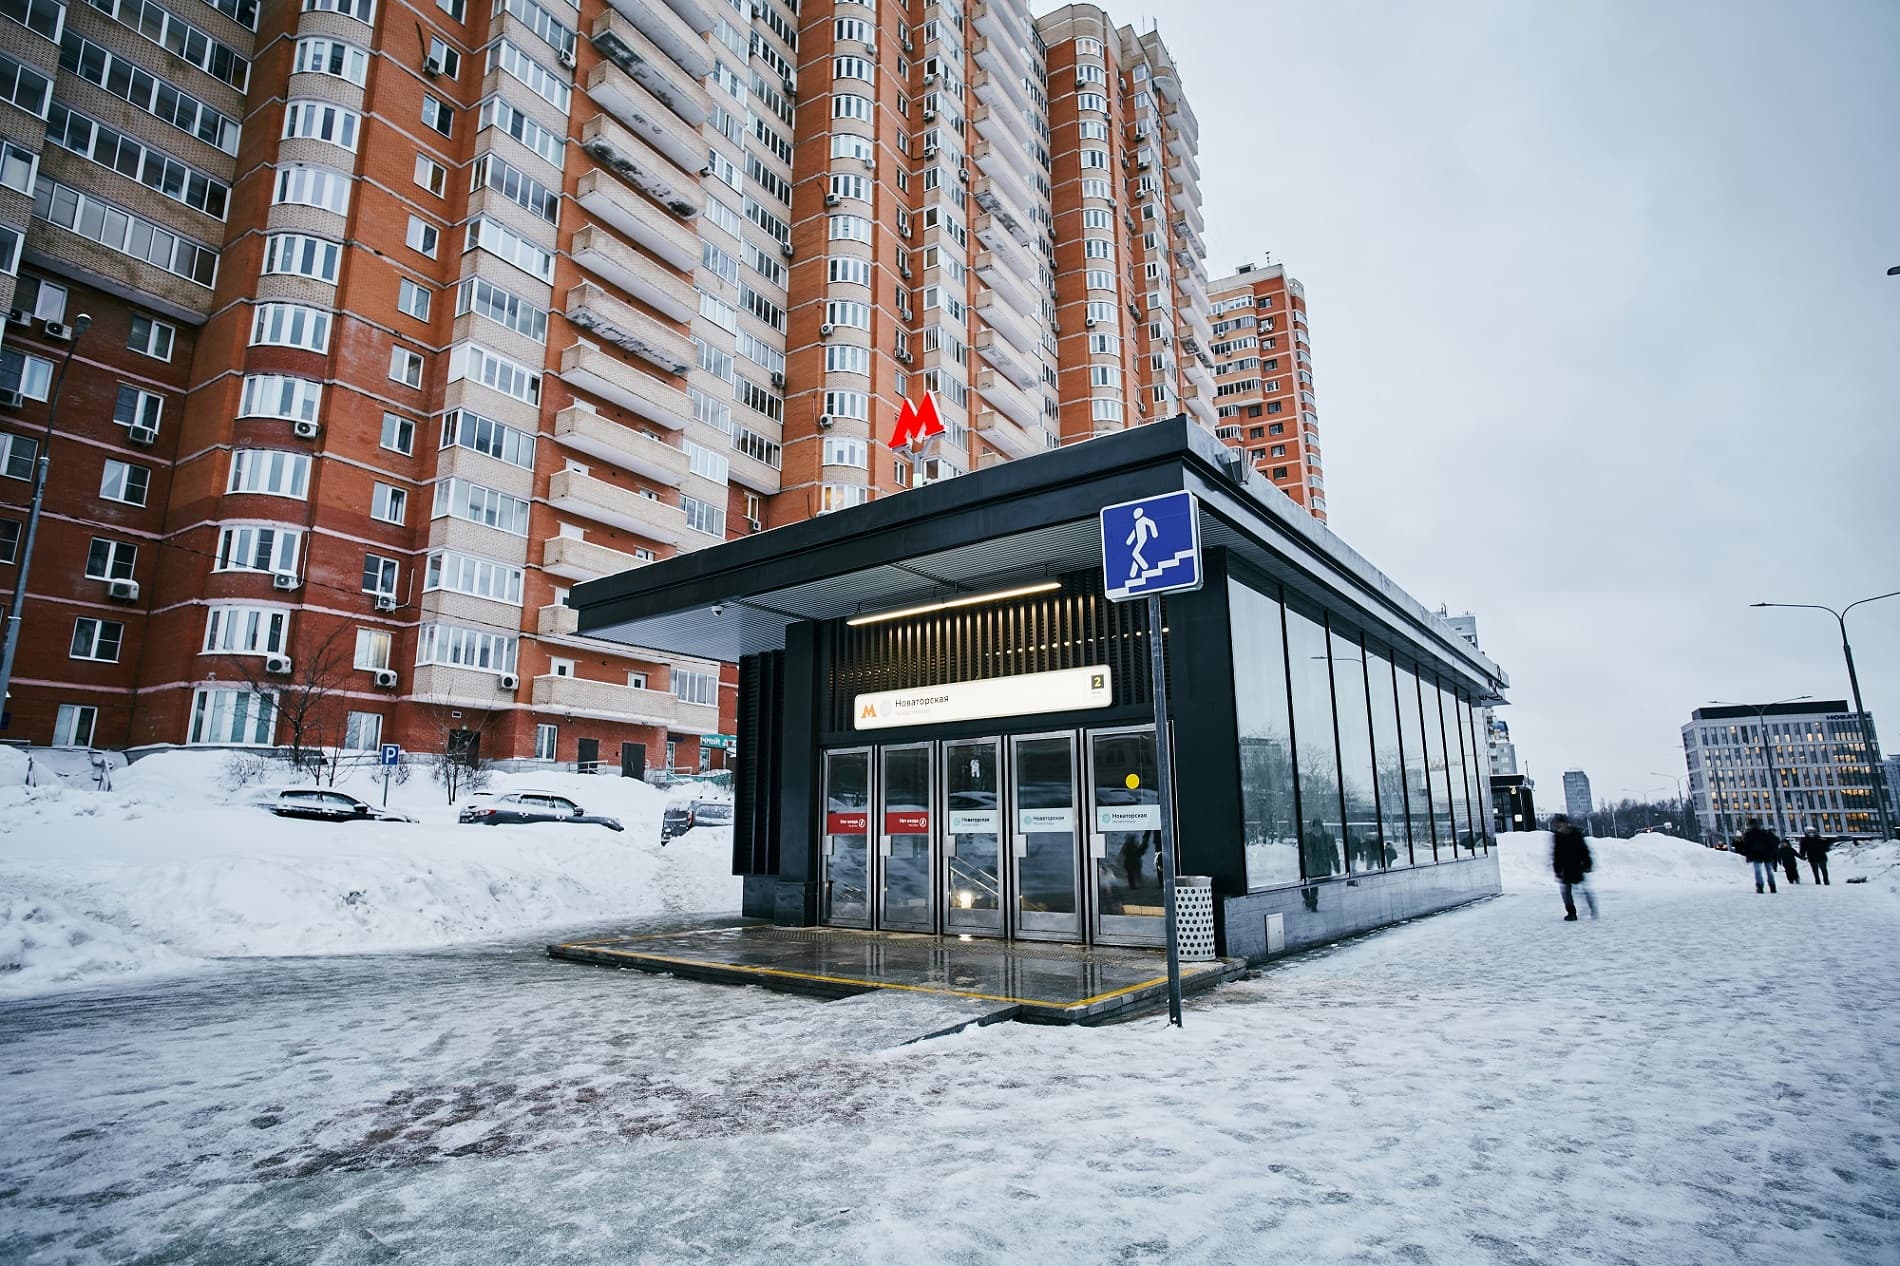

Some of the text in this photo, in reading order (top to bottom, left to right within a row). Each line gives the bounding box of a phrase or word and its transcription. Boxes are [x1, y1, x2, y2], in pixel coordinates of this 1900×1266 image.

[1094, 676, 1101, 687] 2
[895, 695, 949, 708] Новаторская
[386, 747, 396, 763] P
